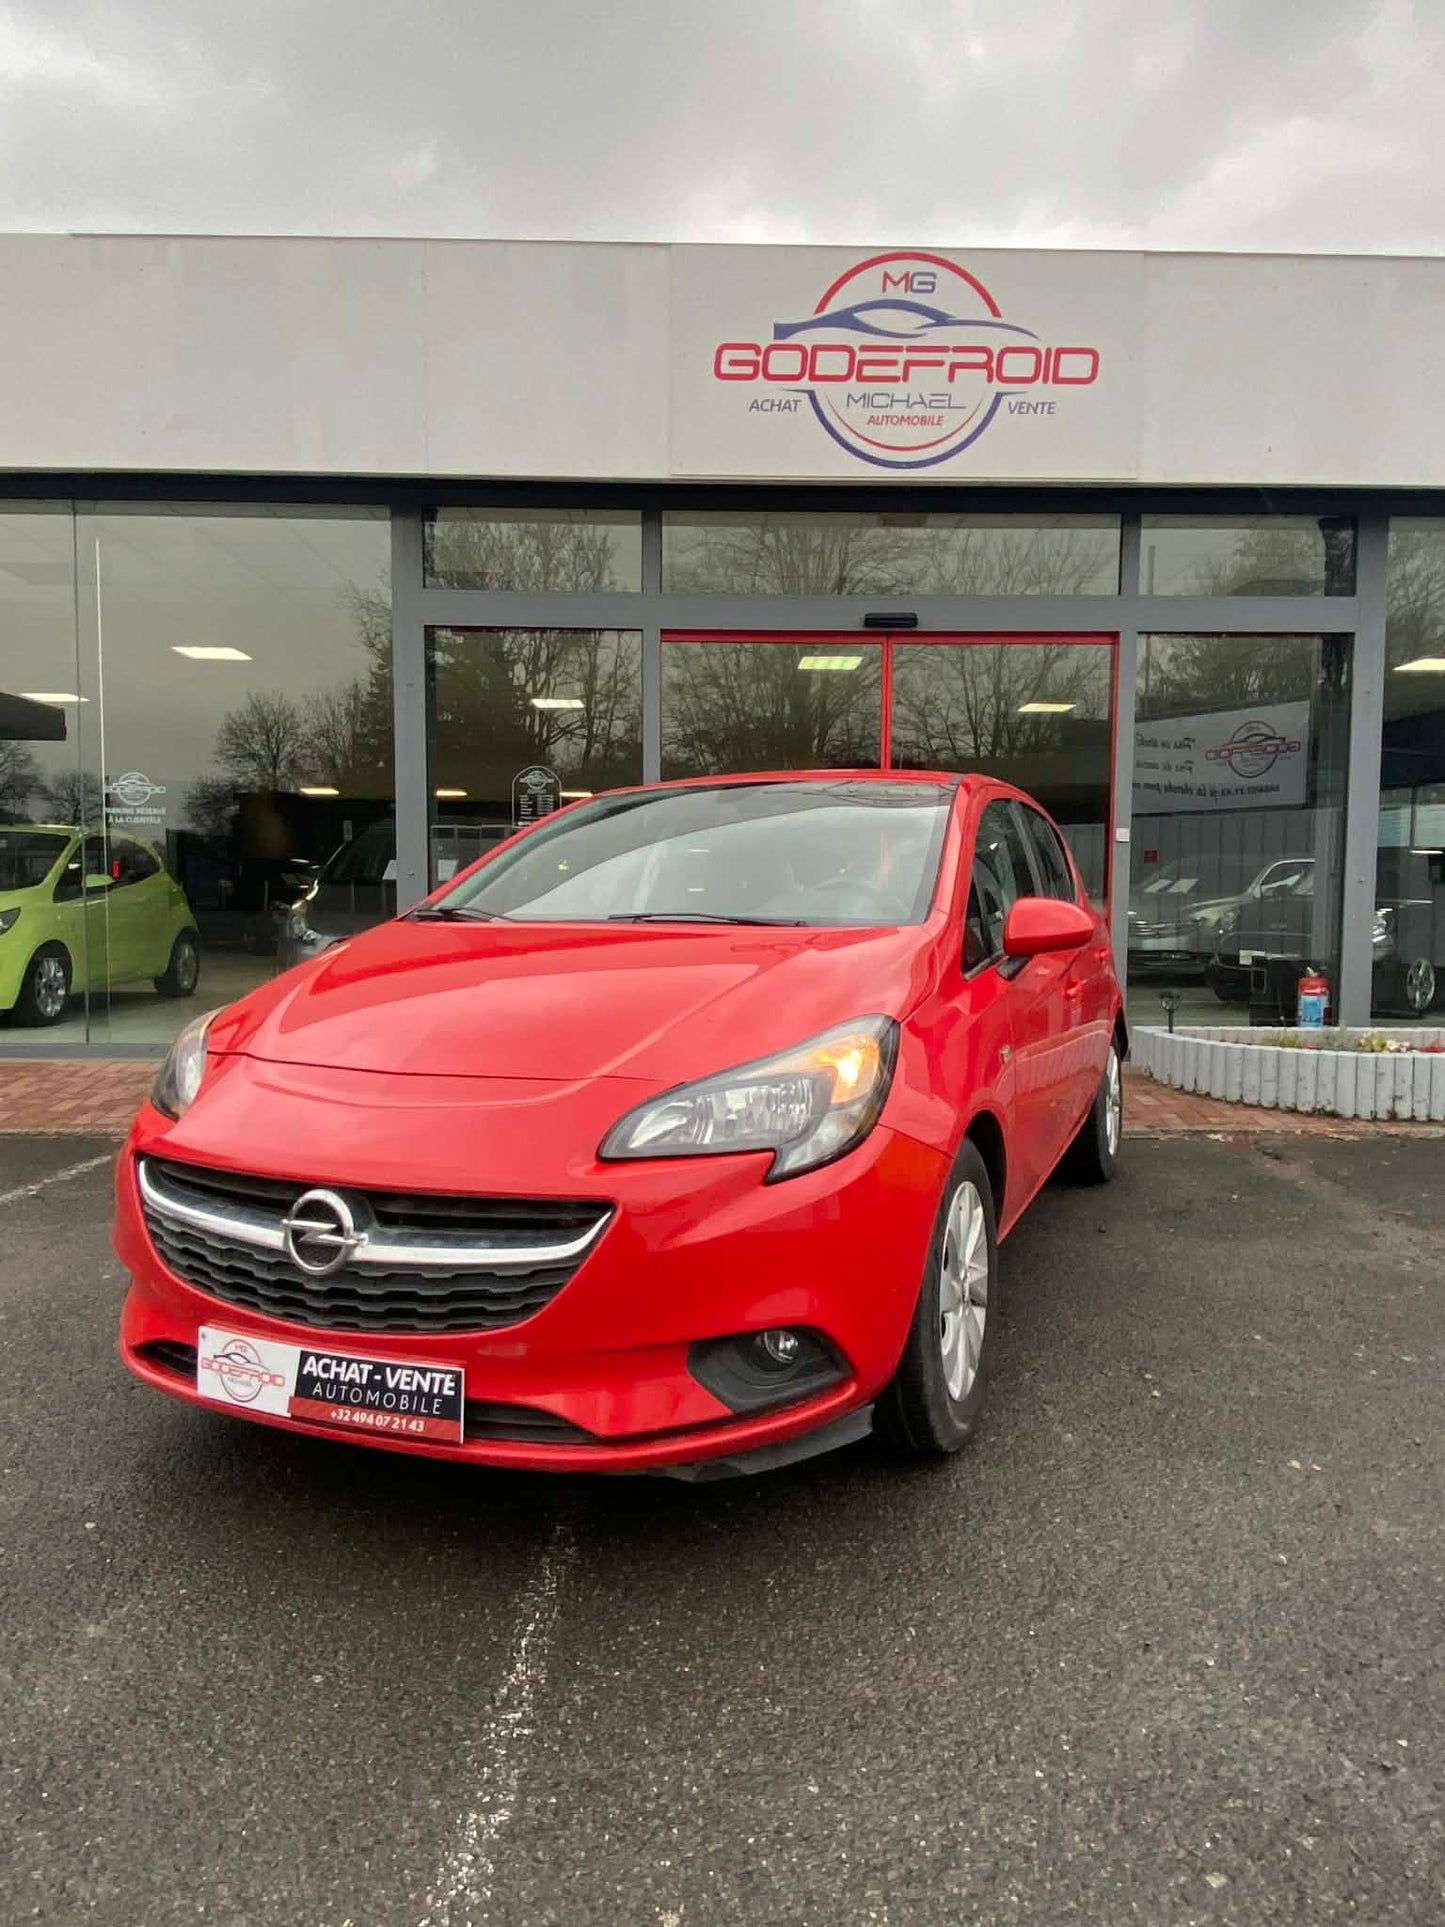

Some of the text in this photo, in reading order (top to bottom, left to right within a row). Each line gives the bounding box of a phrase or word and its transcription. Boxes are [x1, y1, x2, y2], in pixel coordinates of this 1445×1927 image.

[881, 270, 938, 294] MG
[713, 342, 1100, 385] GODEFROID
[748, 398, 801, 413] ACHAT
[846, 391, 967, 410] MICHAEL
[1007, 400, 1056, 416] VENTE
[866, 414, 945, 427] AUTOMOBILE
[302, 1355, 374, 1385] ACHAT
[385, 1366, 456, 1396] VENTE
[312, 1382, 443, 1415] AUTOMOBILE
